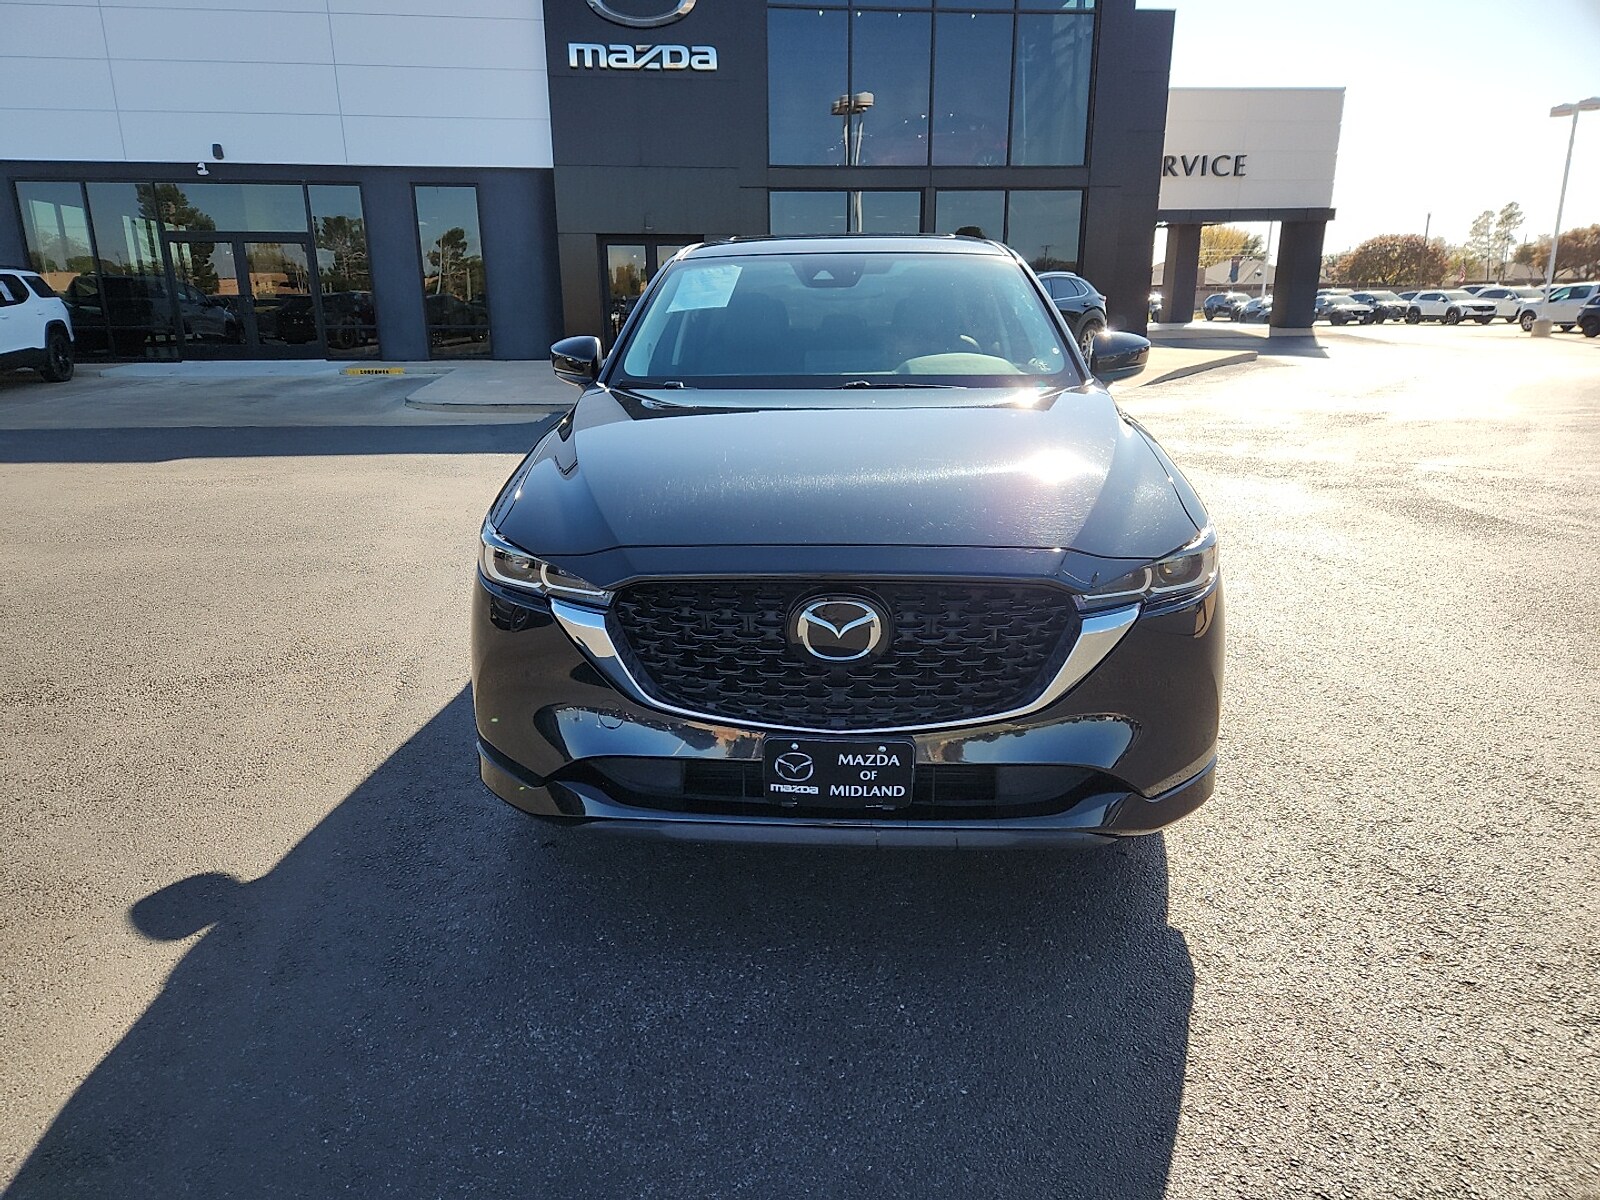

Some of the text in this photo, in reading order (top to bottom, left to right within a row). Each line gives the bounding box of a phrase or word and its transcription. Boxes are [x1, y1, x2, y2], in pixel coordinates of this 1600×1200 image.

[837, 754, 900, 767] MAZDA
[859, 770, 878, 781] OF
[829, 785, 906, 797] MIDLAND
